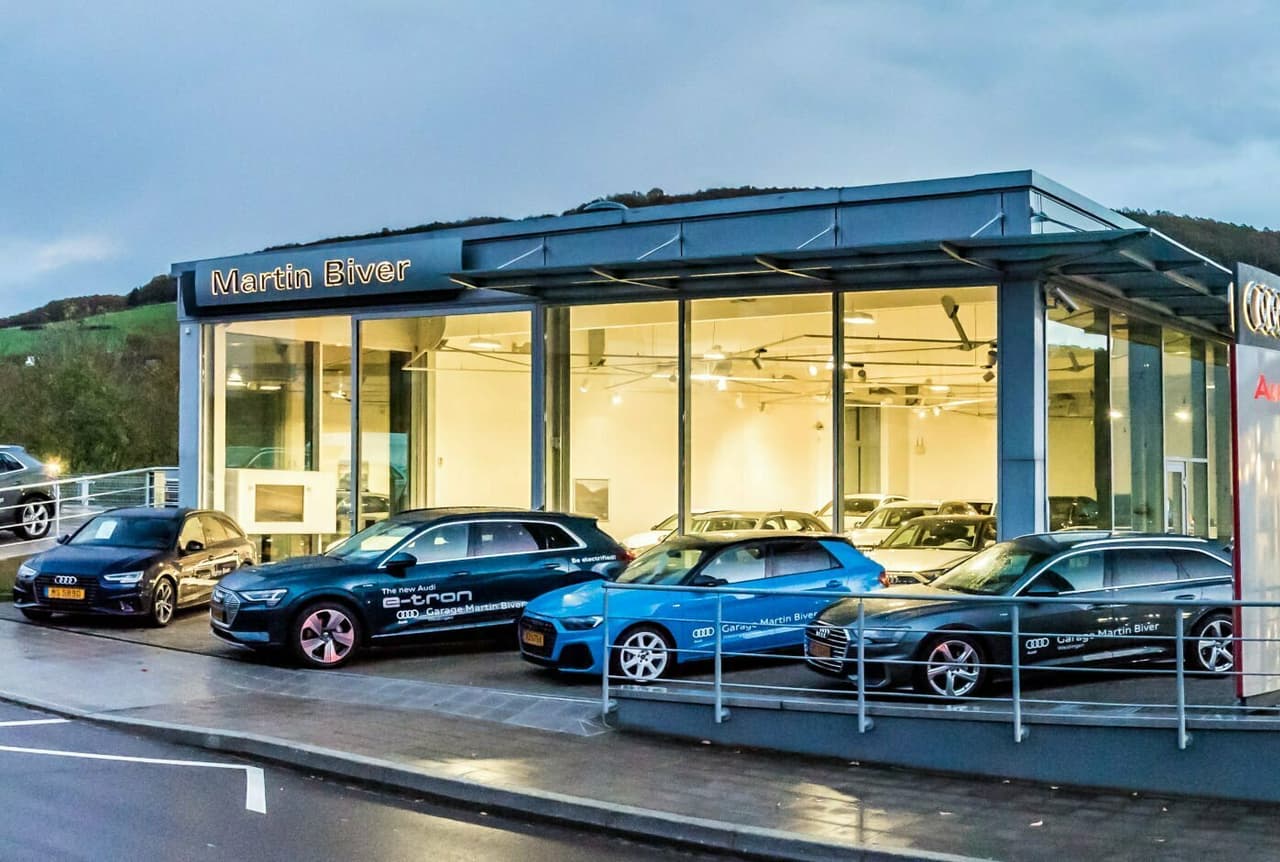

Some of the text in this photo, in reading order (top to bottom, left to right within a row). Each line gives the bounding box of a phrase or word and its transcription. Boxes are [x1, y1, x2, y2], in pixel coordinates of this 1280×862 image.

[211, 258, 411, 296] Martin Biver
[382, 583, 437, 596] The new Audi
[382, 590, 473, 609] e-tron
[426, 606, 463, 618] Garage
[465, 603, 500, 614] Martin
[760, 616, 792, 626] Martin
[794, 611, 818, 622] Biver
[1098, 623, 1132, 637] Martin
[1134, 621, 1160, 634] Biver
